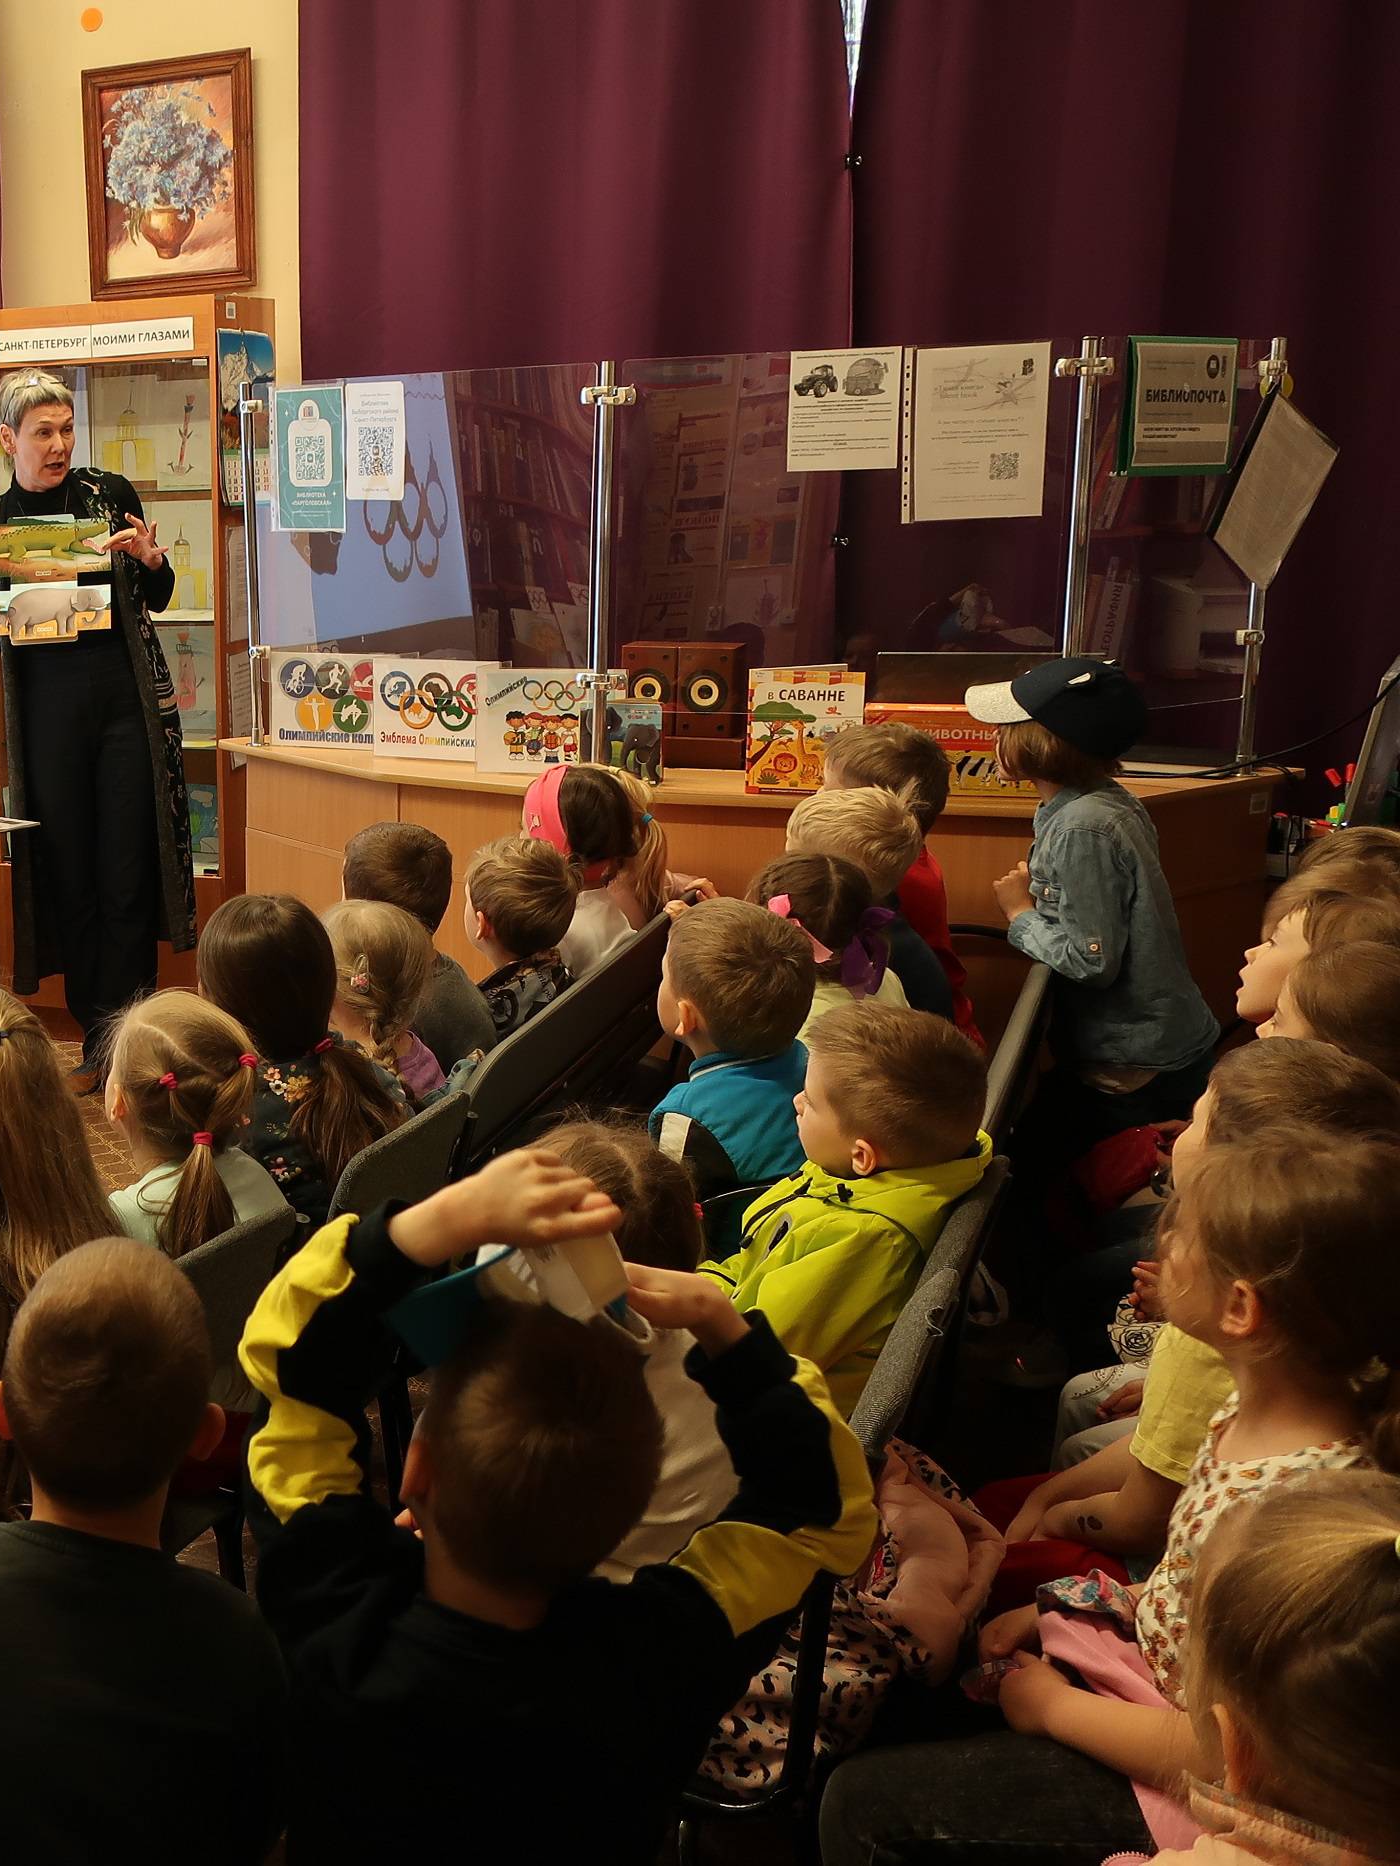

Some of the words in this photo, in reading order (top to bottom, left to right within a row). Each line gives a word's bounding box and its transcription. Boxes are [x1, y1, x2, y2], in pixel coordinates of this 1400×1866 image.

[92, 334, 136, 347] МОИМИ
[138, 329, 190, 343] ГЛАЗАМИ
[1145, 389, 1226, 403] БИБЛИОПОЧТА
[484, 675, 529, 707] Олимпийские
[779, 689, 846, 702] САВАННЕ
[278, 727, 350, 744] Олимпийские
[380, 731, 416, 745] Эмблема
[419, 733, 476, 748] Олимпийских
